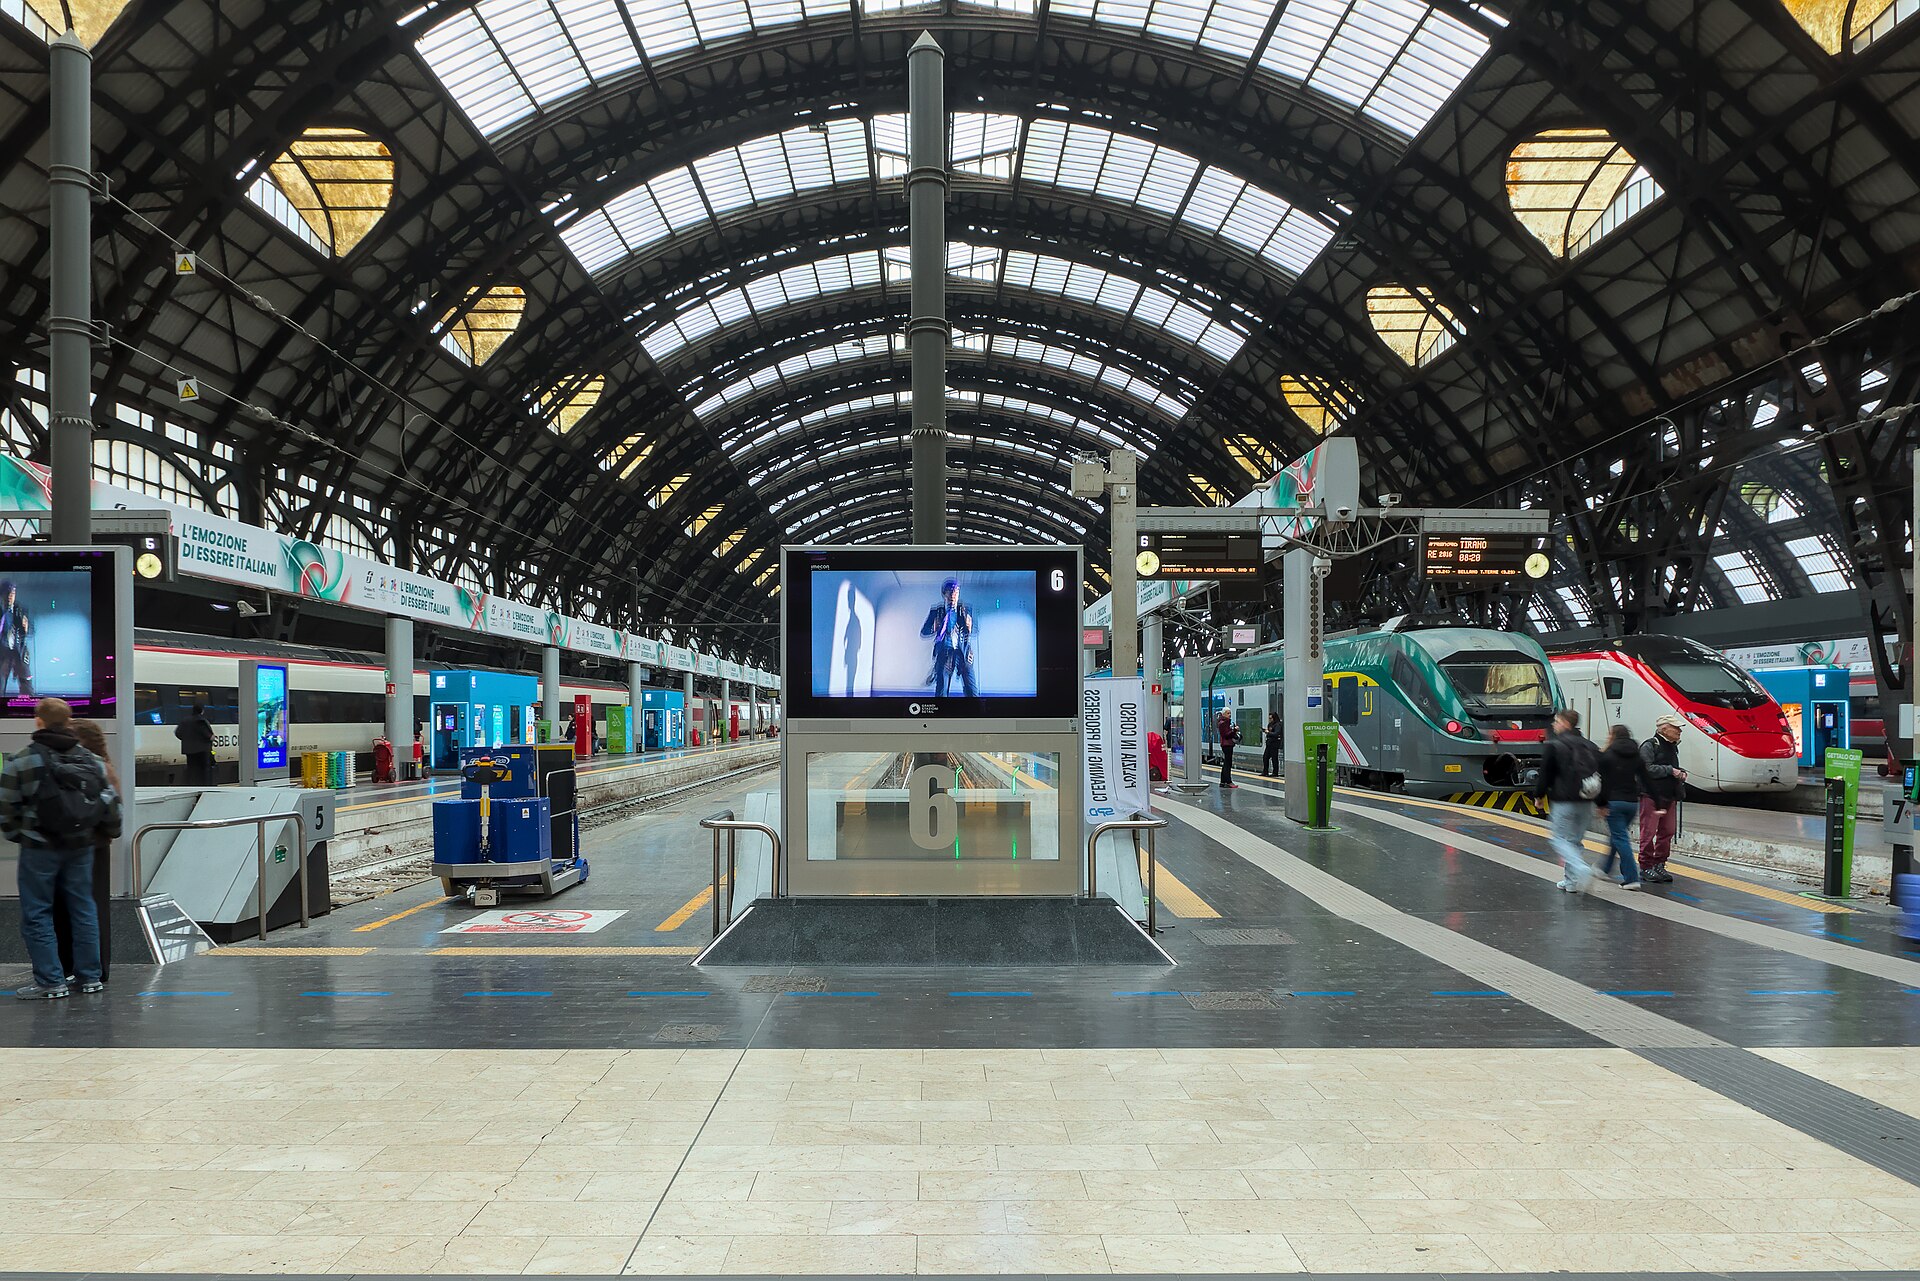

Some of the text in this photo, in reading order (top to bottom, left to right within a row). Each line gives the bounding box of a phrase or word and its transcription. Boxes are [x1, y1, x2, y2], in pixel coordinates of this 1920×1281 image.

[145, 538, 155, 549] 5
[182, 523, 248, 552] L'EMOZIONE
[1140, 535, 1149, 547] 6
[1460, 541, 1487, 549] TIRANO
[1537, 537, 1546, 550] 7
[182, 542, 277, 577] DI ESSERE ITALIANI
[1427, 550, 1438, 559] RE
[1050, 569, 1064, 591] 6
[400, 581, 435, 600] L'EMOZIONE
[400, 595, 451, 616] DI ESSERE ITALIANI
[212, 734, 240, 747] SBB C
[1826, 752, 1849, 760] GETTALO
[908, 764, 958, 850] 6
[1892, 799, 1906, 824] 7
[315, 805, 324, 831] 5
